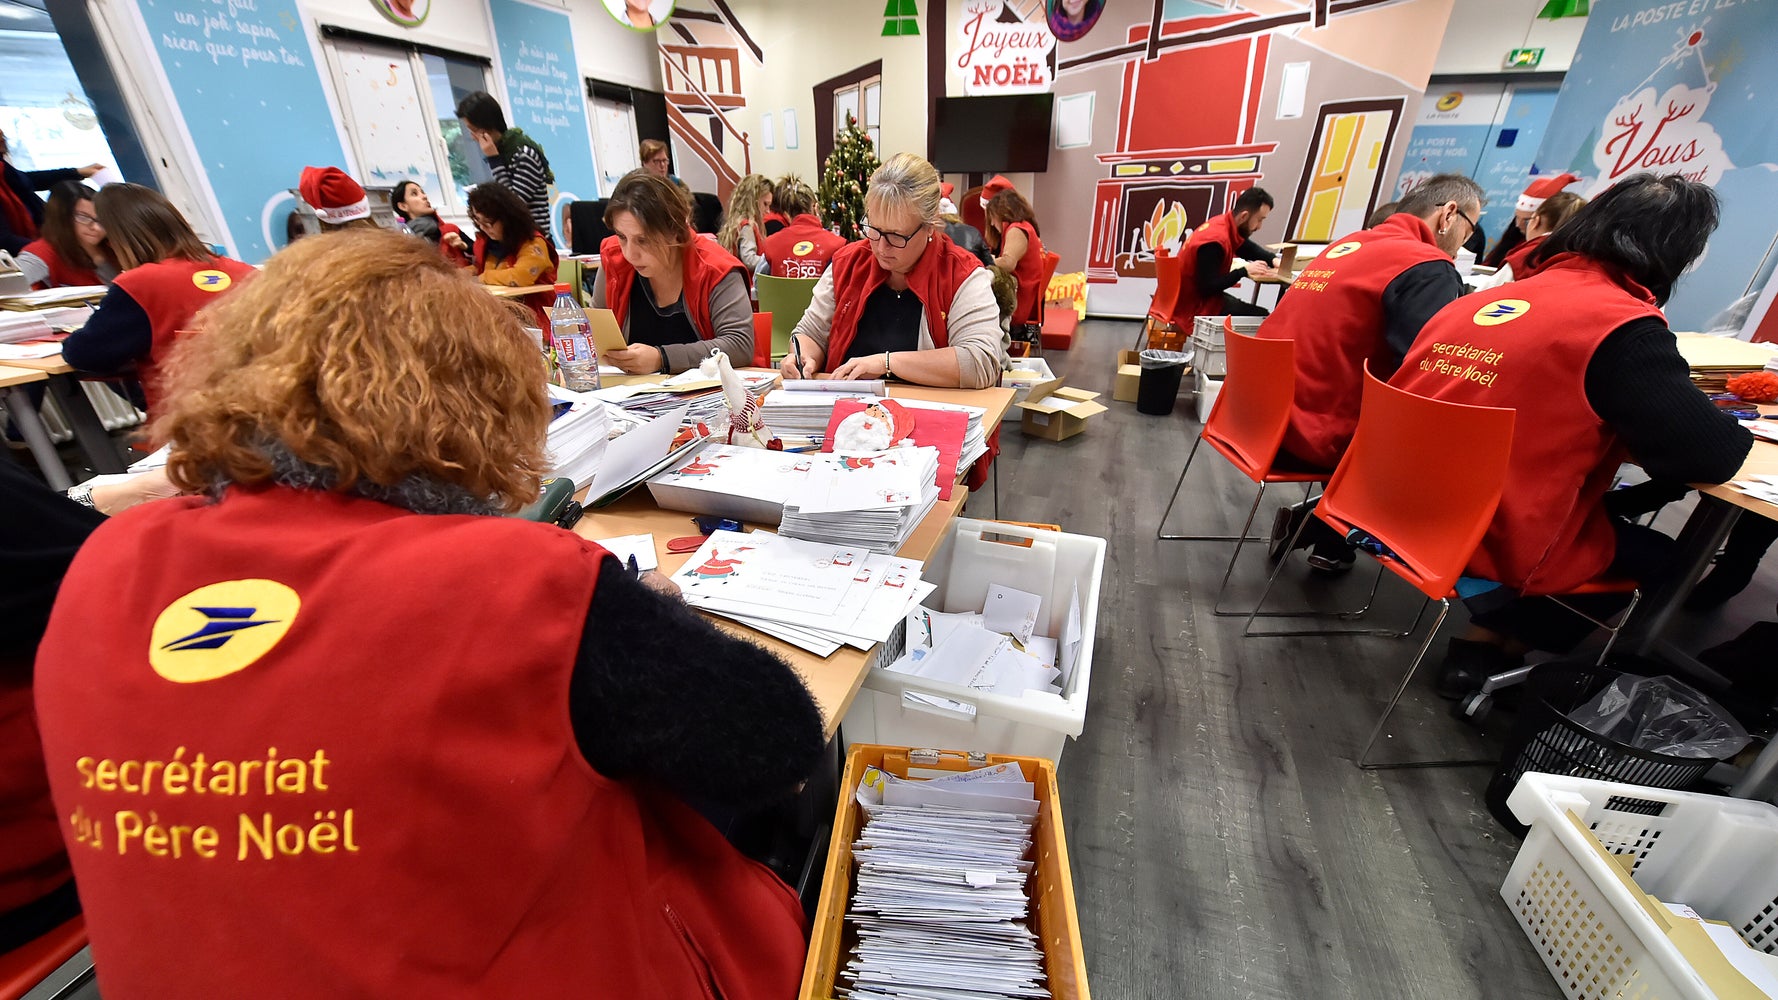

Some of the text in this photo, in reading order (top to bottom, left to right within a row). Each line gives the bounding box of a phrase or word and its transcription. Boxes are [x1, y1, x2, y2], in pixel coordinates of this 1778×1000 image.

[174, 11, 200, 27] un
[203, 9, 232, 38] joli
[1610, 14, 1630, 32] LA
[1632, 1, 1686, 28] POSTE
[1687, 0, 1709, 16] ET
[162, 30, 202, 53] rien
[205, 42, 238, 65] que
[241, 46, 279, 69] pour
[958, 11, 1049, 68] Joyeux
[972, 57, 1044, 87] NOËL
[1407, 148, 1418, 157] LE
[1413, 137, 1457, 147] LA POSTE
[1605, 116, 1705, 179] Vous
[800, 266, 816, 279] 50
[1431, 342, 1505, 367] secrétariat
[1419, 356, 1498, 388] du Père Noël
[75, 745, 331, 796] secrétariat
[115, 810, 220, 860] Père
[237, 807, 361, 862] Noël
